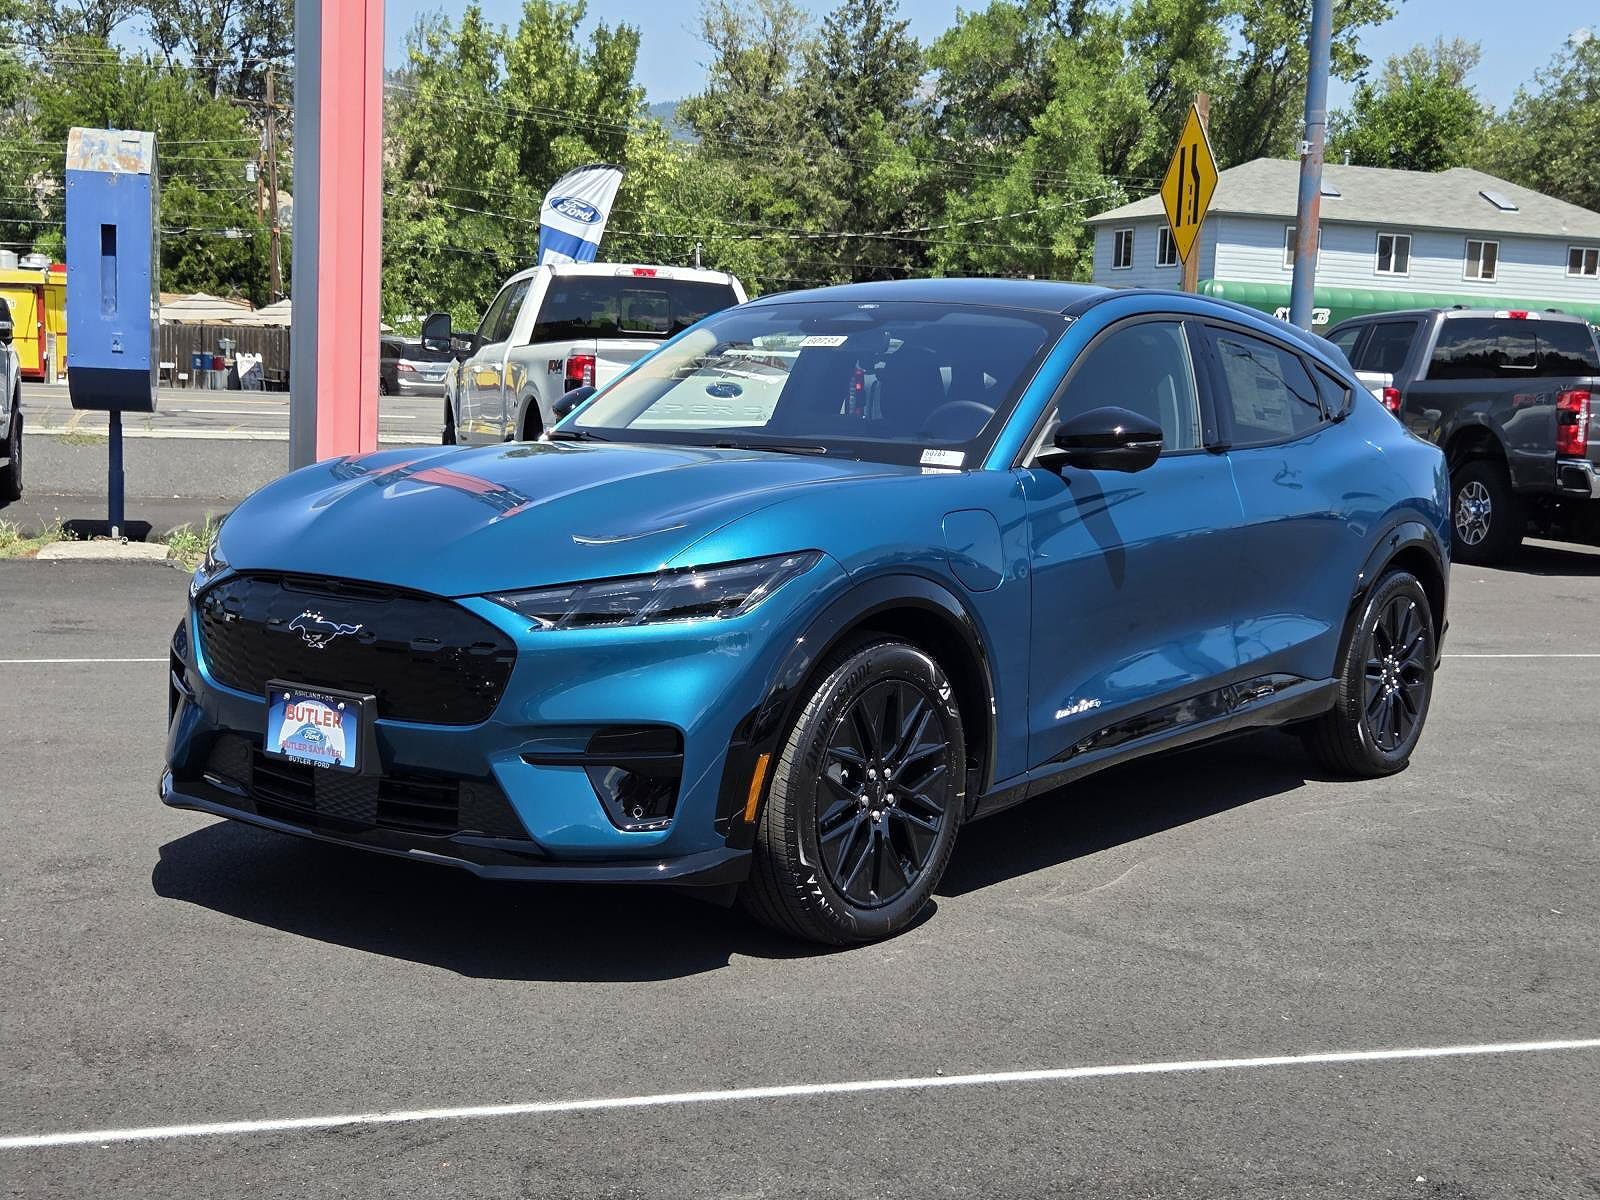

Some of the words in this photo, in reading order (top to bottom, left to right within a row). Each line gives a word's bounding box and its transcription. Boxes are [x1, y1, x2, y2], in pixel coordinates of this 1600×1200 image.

[557, 200, 595, 222] Ford
[286, 703, 342, 729] BUTLER
[303, 729, 322, 742] Ford
[281, 739, 308, 753] BUTLER
[288, 755, 311, 766] BUTLER
[314, 760, 331, 769] FORD
